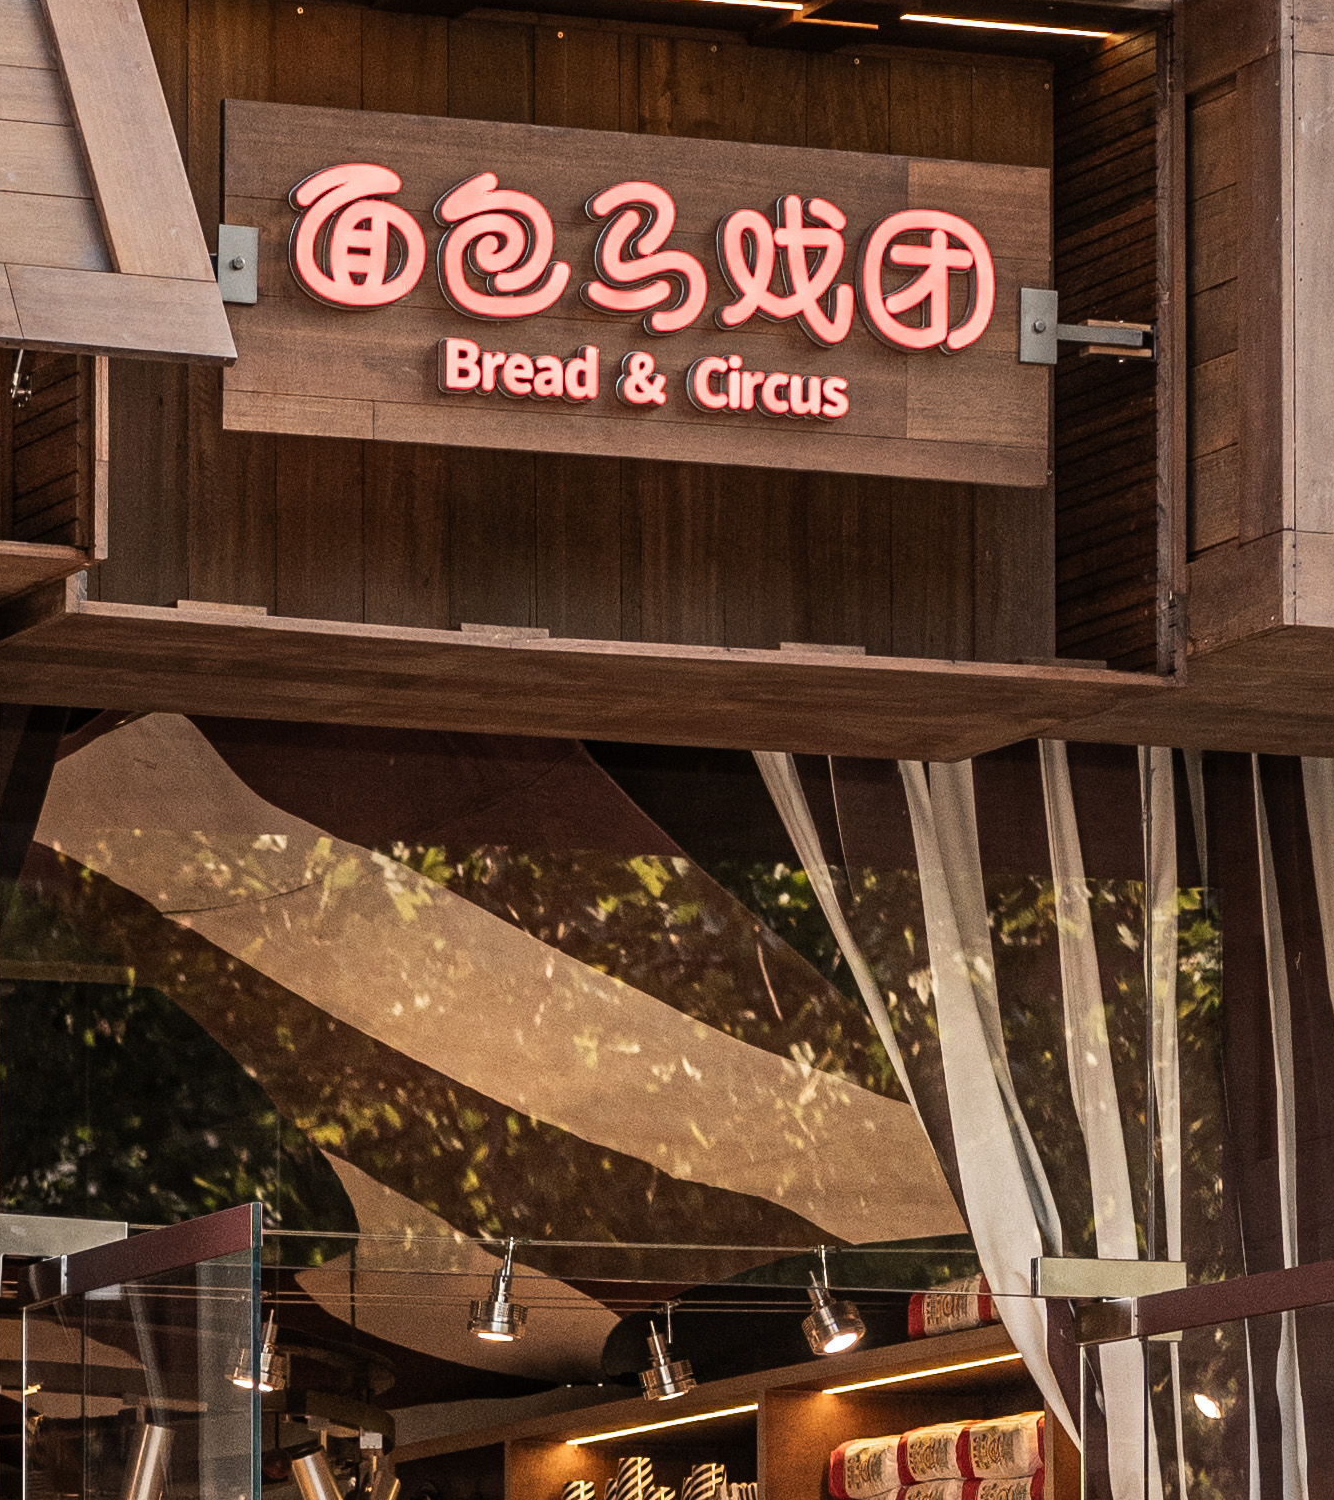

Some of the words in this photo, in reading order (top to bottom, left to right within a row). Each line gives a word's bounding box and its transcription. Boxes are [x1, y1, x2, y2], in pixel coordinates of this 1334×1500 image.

[288, 162, 995, 354] 面包马戏团
[440, 337, 599, 404] Bread
[618, 351, 666, 407] &
[689, 355, 850, 419] Circus
